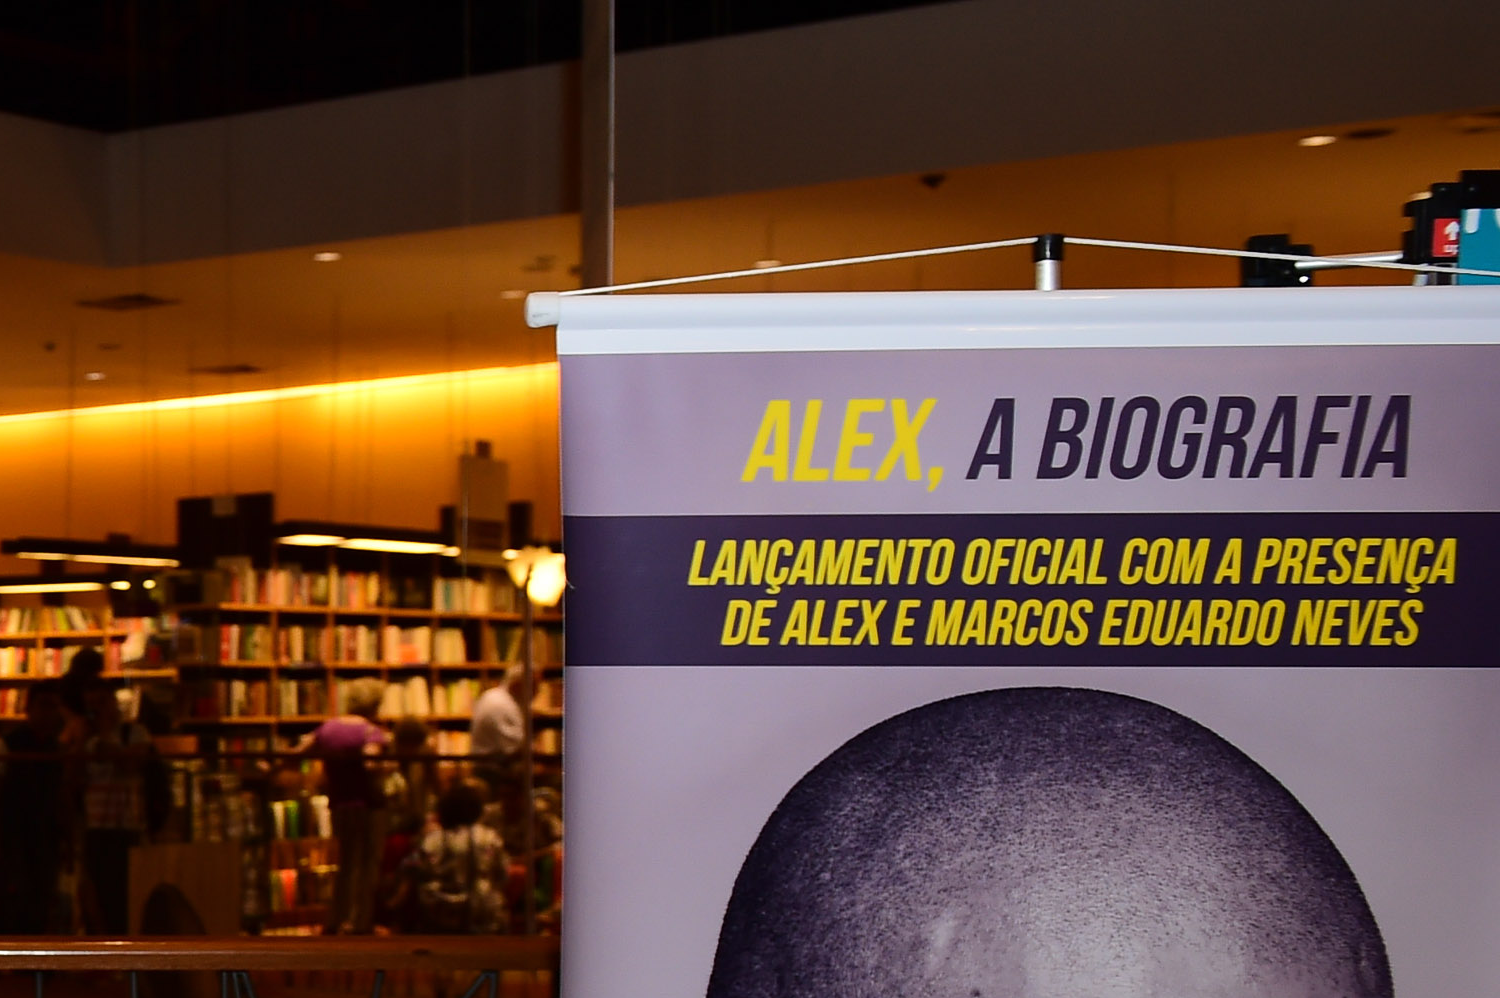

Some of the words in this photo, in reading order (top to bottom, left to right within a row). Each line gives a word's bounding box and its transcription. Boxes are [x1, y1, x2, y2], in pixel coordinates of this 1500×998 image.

[741, 398, 944, 492] ALEX,
[965, 397, 1016, 481] A
[1035, 394, 1412, 481] BIOGRAFIA
[687, 538, 956, 595] LANÇAMENTO
[961, 537, 1108, 586] OFICIAL
[1118, 537, 1211, 585] COM
[1213, 537, 1243, 585] A
[1251, 537, 1458, 594] PRESENÇA
[720, 599, 778, 646] DE
[780, 599, 887, 646] ALEX
[891, 599, 922, 646] E
[924, 599, 1094, 646] MARCOS
[1098, 598, 1286, 646] EDUARDO
[1290, 598, 1425, 646] NEVES
